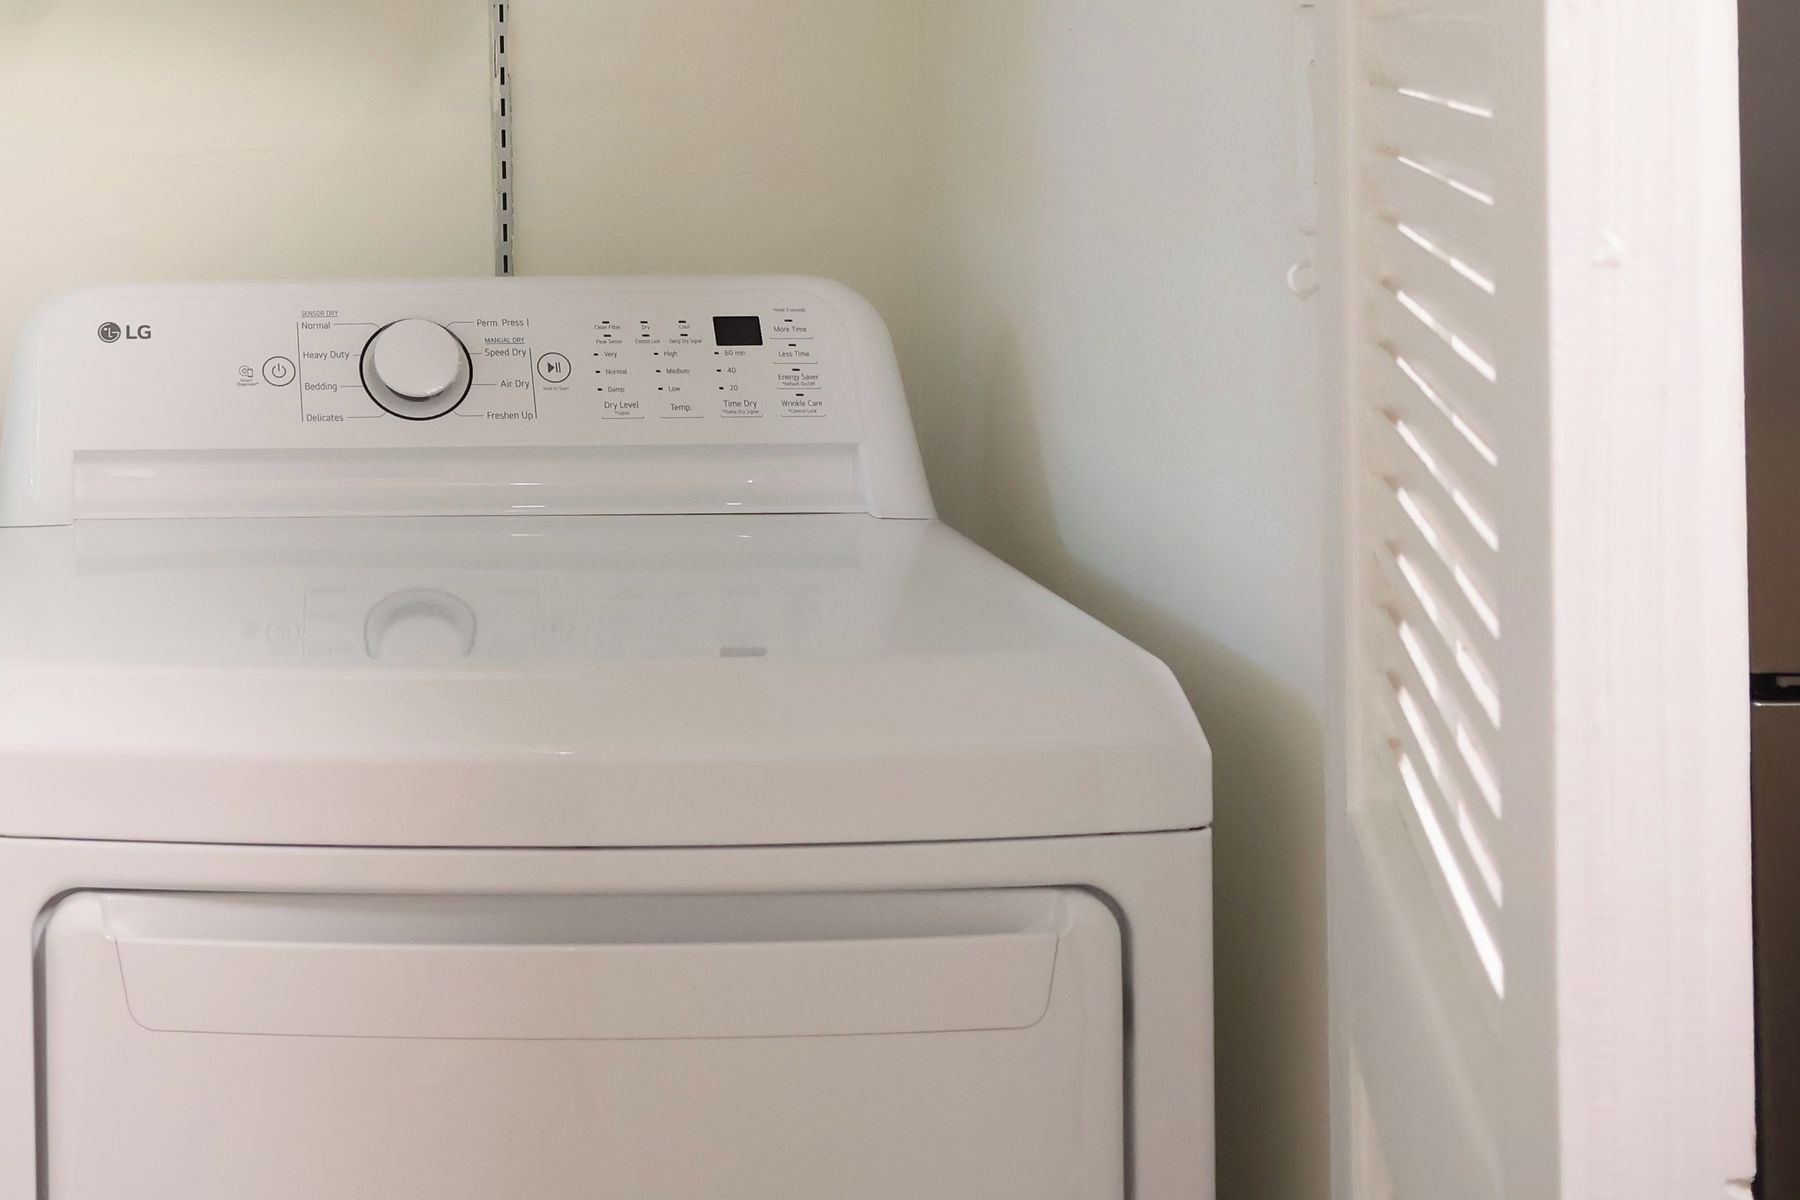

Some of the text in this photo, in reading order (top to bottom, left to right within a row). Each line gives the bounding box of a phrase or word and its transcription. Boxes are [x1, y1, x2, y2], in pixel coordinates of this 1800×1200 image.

[301, 322, 331, 330] Normal
[476, 319, 525, 327] Perm. Press
[126, 325, 152, 340] LG
[303, 350, 350, 361] Heavy Duty
[485, 348, 527, 359] Speed Dry
[778, 374, 800, 382] Energy
[304, 382, 338, 393] Bedding
[500, 380, 530, 390] Air Dry
[604, 400, 640, 410] Dry Level
[670, 403, 691, 412] Temp
[723, 400, 757, 409] Time Dry
[306, 413, 344, 422] Delicates
[487, 411, 534, 421] Freshen Up
